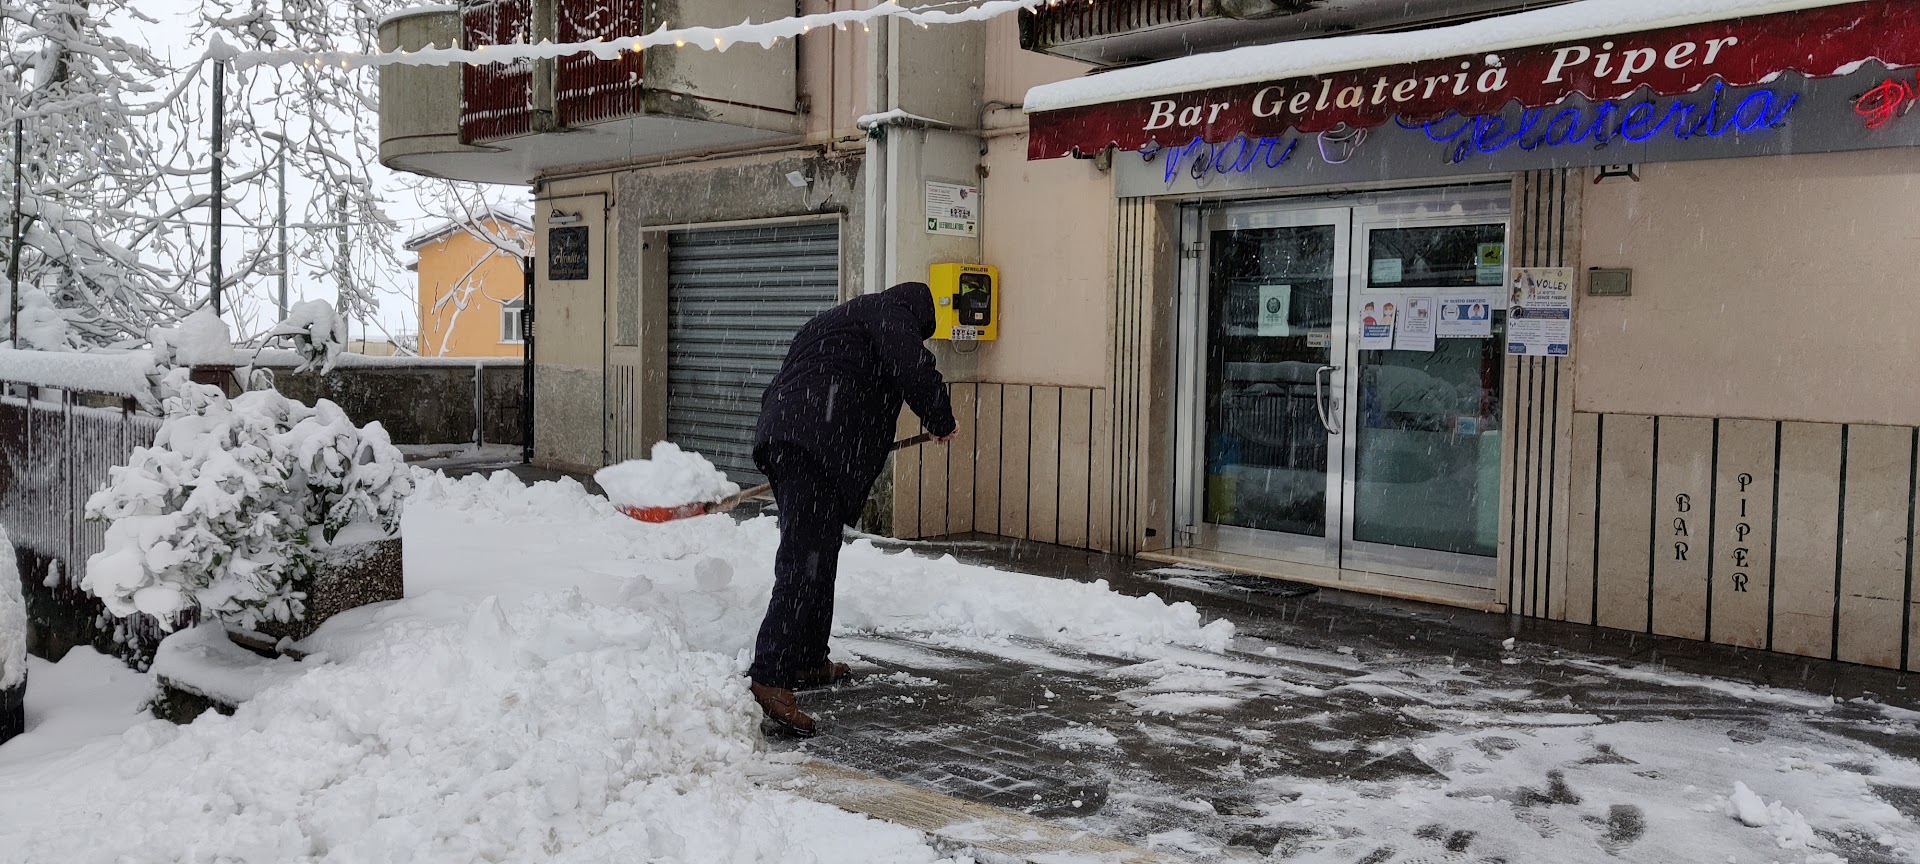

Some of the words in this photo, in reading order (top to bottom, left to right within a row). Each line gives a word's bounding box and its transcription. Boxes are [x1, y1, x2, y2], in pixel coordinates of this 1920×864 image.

[1142, 100, 1230, 131] Bar
[1252, 60, 1508, 118] Gelateria
[1541, 35, 1738, 85] Piper
[1536, 278, 1568, 291] VOLLEY
[1673, 493, 1691, 561] BAR
[1731, 472, 1753, 593] PIPER
